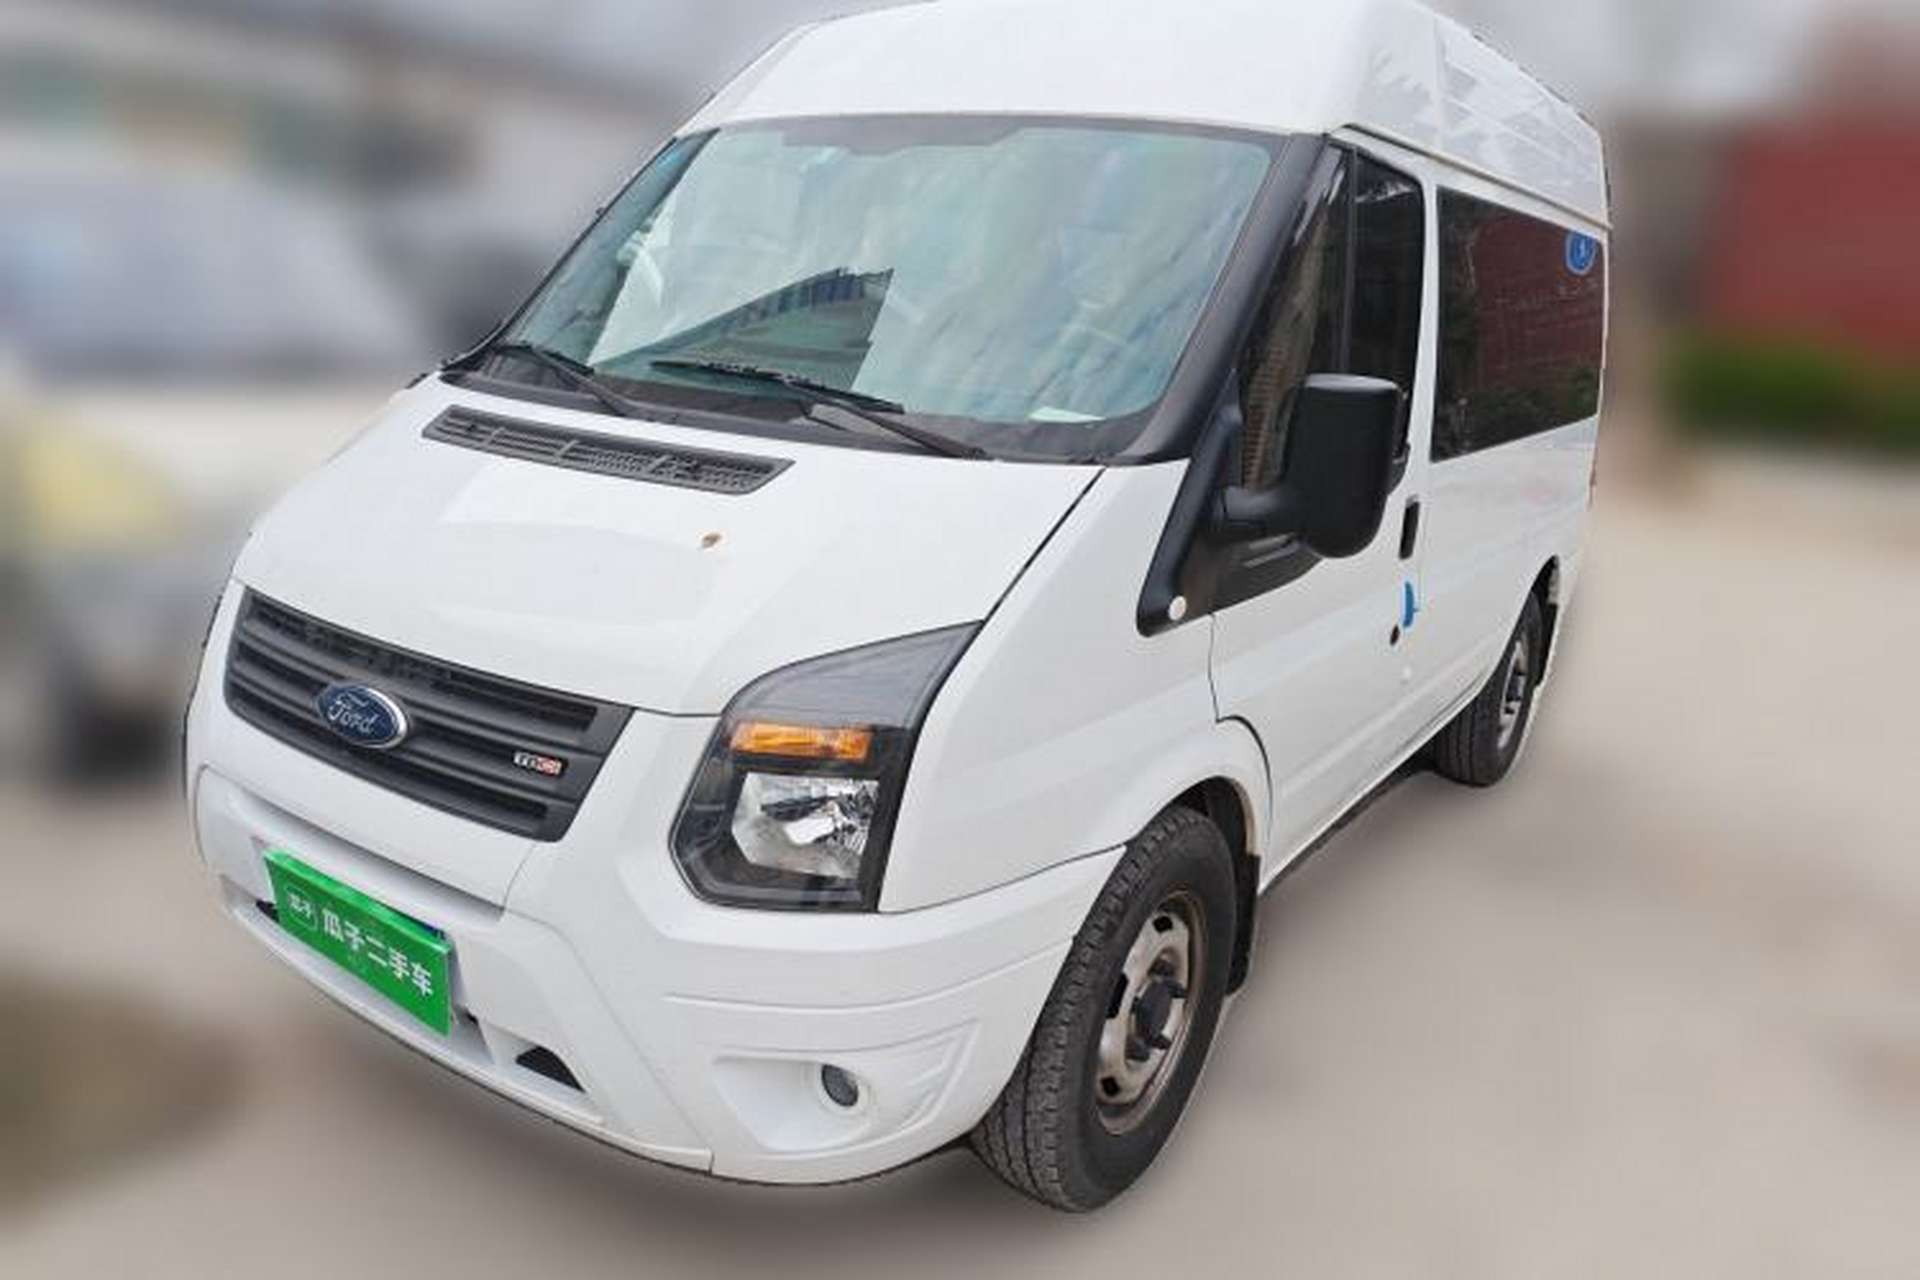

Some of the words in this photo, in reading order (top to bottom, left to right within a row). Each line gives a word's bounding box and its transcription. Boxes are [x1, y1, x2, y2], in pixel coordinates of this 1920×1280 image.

[328, 691, 379, 735] Ford
[321, 907, 434, 997] 瓜子二手车
